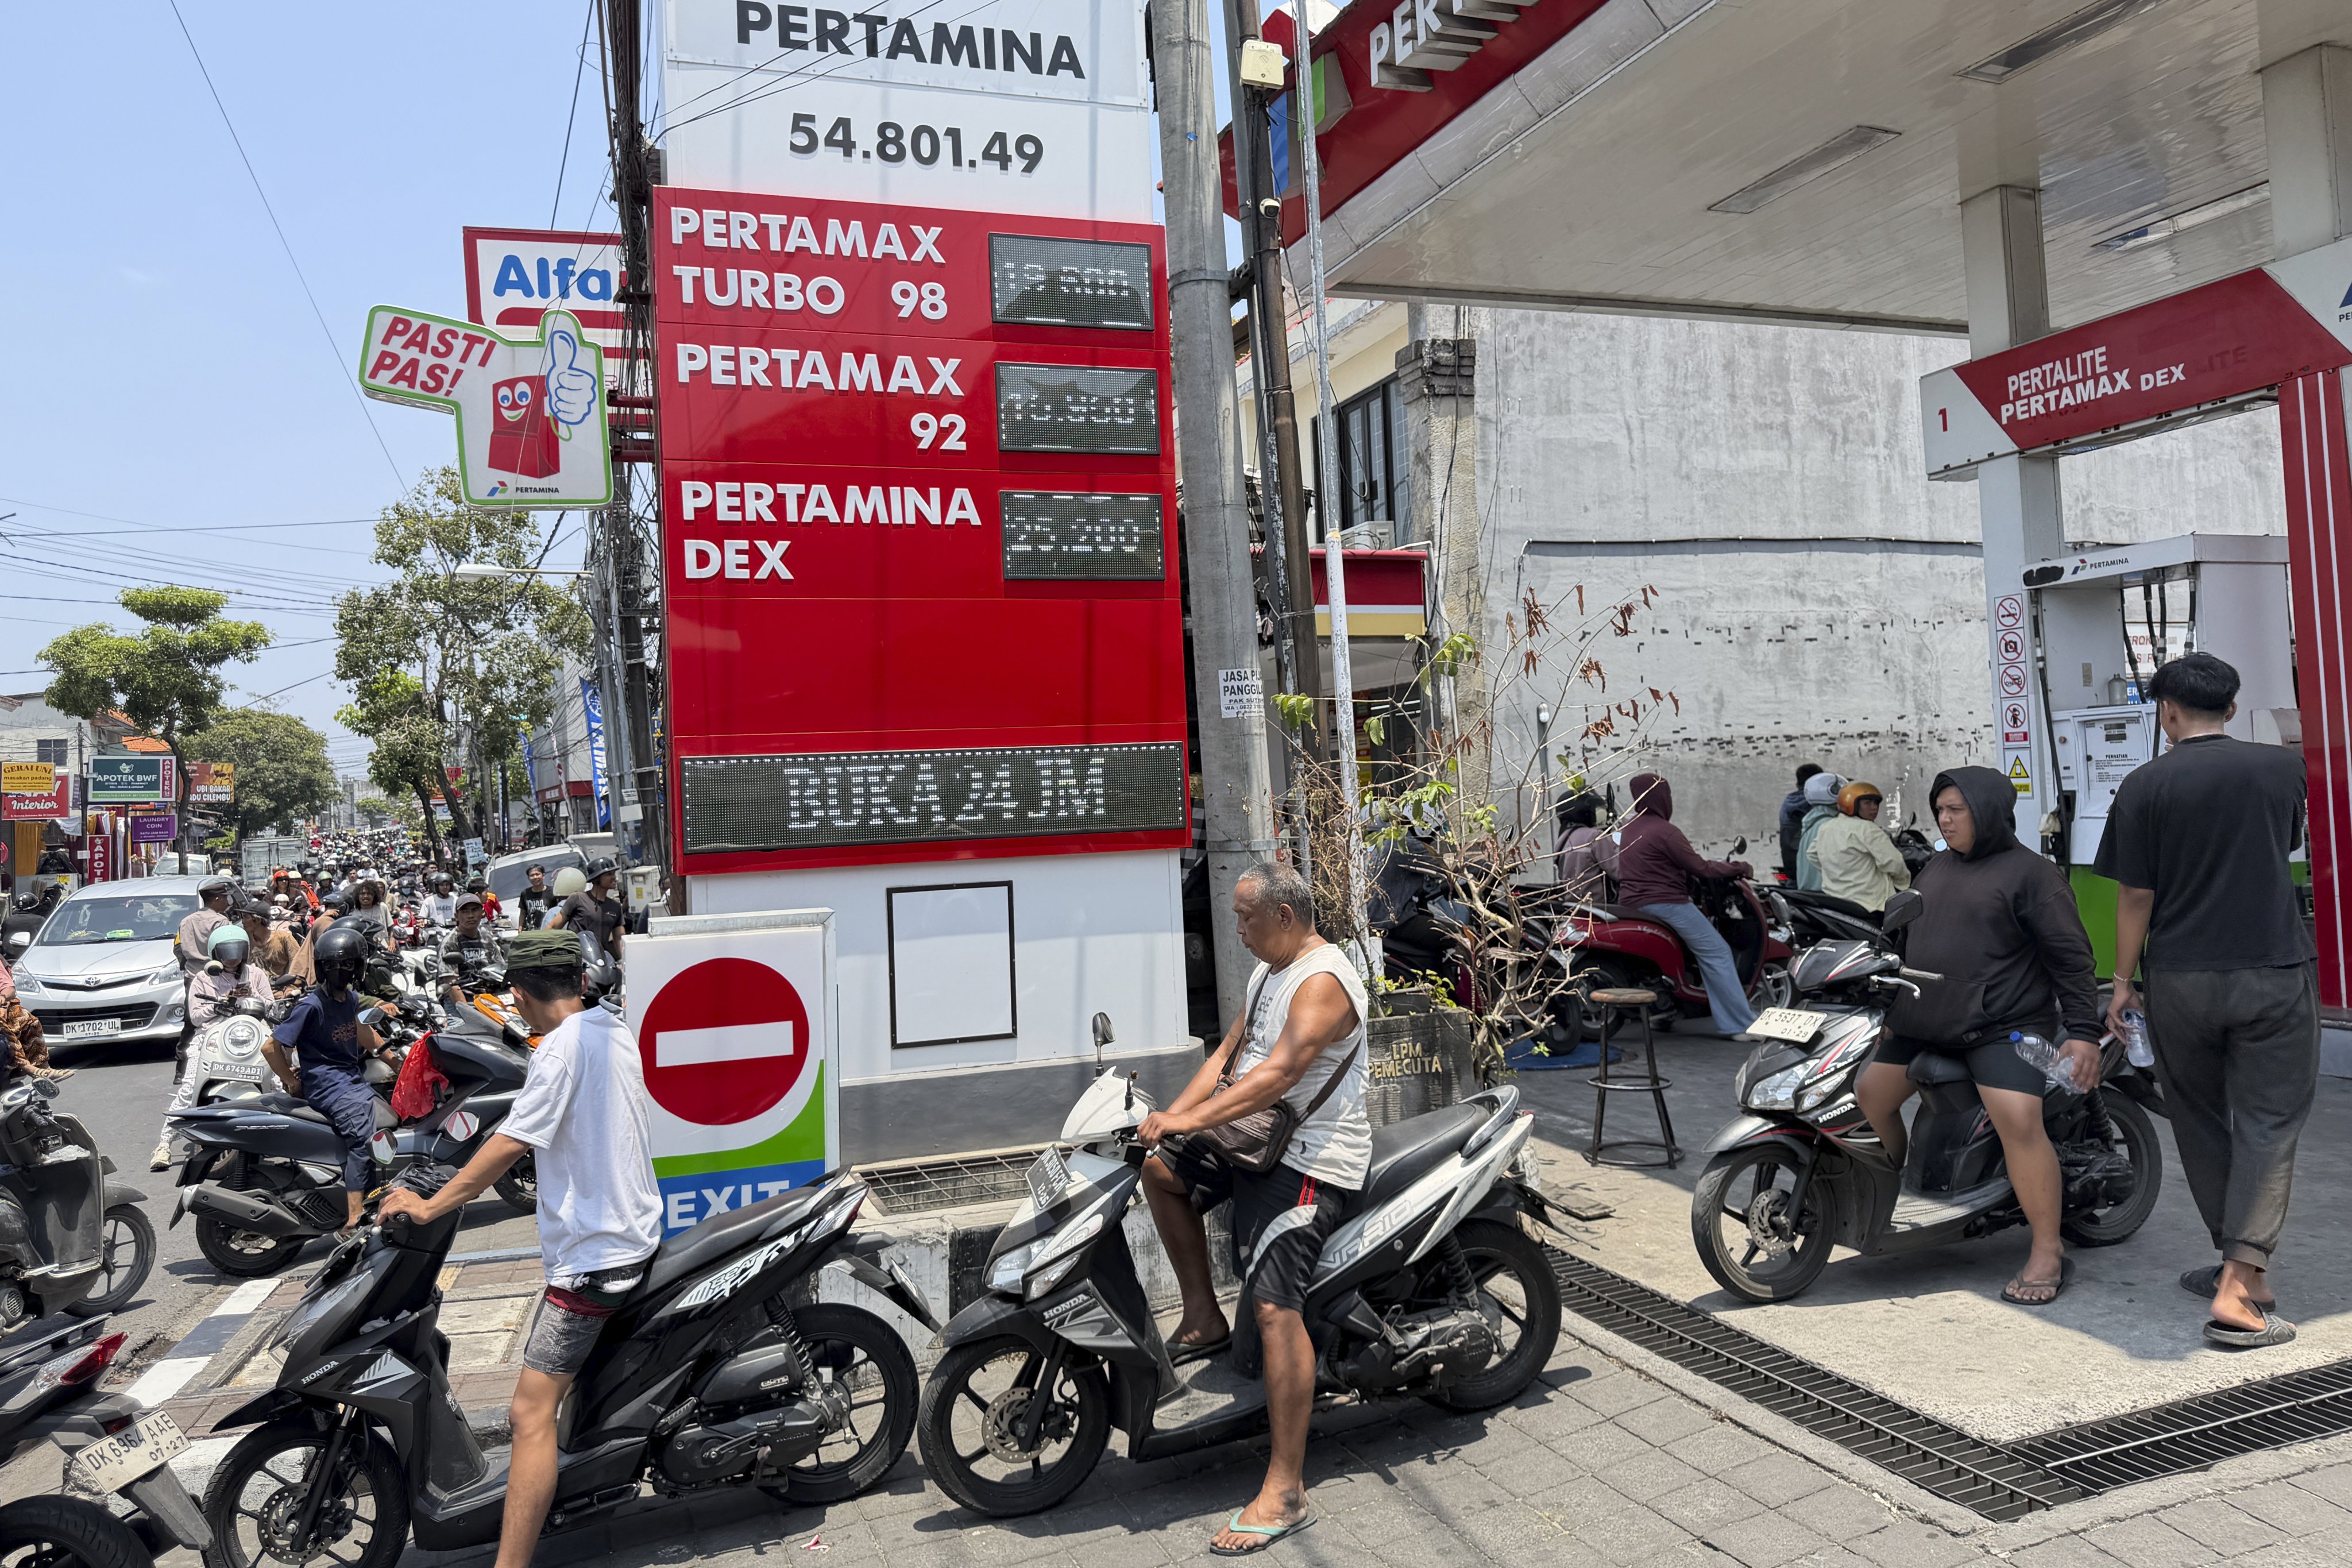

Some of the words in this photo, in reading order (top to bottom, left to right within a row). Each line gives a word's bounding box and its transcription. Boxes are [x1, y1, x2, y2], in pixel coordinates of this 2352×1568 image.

[737, 0, 1086, 79] PERTAMINA
[790, 112, 1044, 174] 54.801.49
[671, 207, 946, 264] PERTAMAX
[493, 254, 612, 301] Alfa
[673, 265, 845, 314] TURBO
[891, 281, 948, 319] 98
[2339, 311, 2352, 322] PE
[380, 316, 497, 368] PASTI
[368, 350, 464, 397] PAS!
[677, 343, 964, 396] PERTAMAX
[2007, 346, 2108, 400] PERTALITE
[2000, 369, 2131, 425] PERTAMAX
[2140, 364, 2186, 391] DEX
[910, 413, 967, 451] 92
[1938, 407, 1949, 432] 1
[515, 486, 559, 494] PERTAMINA
[681, 481, 982, 526] PERTAMINA
[683, 539, 794, 580] DEX
[2090, 558, 2129, 570] PERTAMINA
[1223, 670, 1249, 682] JASA
[1223, 683, 1263, 697] PANGGIL
[3, 764, 34, 774] GERAI
[36, 764, 52, 774] UNI
[196, 785, 207, 793] UBI
[209, 785, 231, 793] BAKAR
[203, 793, 231, 801] CILEMBU
[783, 763, 946, 828] BUKA
[955, 764, 1018, 821] 24
[11, 799, 59, 810] Interior
[65, 1024, 76, 1034] DK
[80, 1022, 103, 1032] 1702
[1760, 1010, 1776, 1020] DK
[1775, 1011, 1802, 1024] 5637
[1803, 1015, 1821, 1027] DX
[1392, 1042, 1422, 1060] LPM
[1817, 1102, 1856, 1123] HONDA
[1042, 1293, 1091, 1319] HONDA
[301, 1361, 339, 1385] HONDA
[86, 1446, 113, 1471] DK
[108, 1428, 146, 1458] 6964
[145, 1413, 176, 1440] AAE
